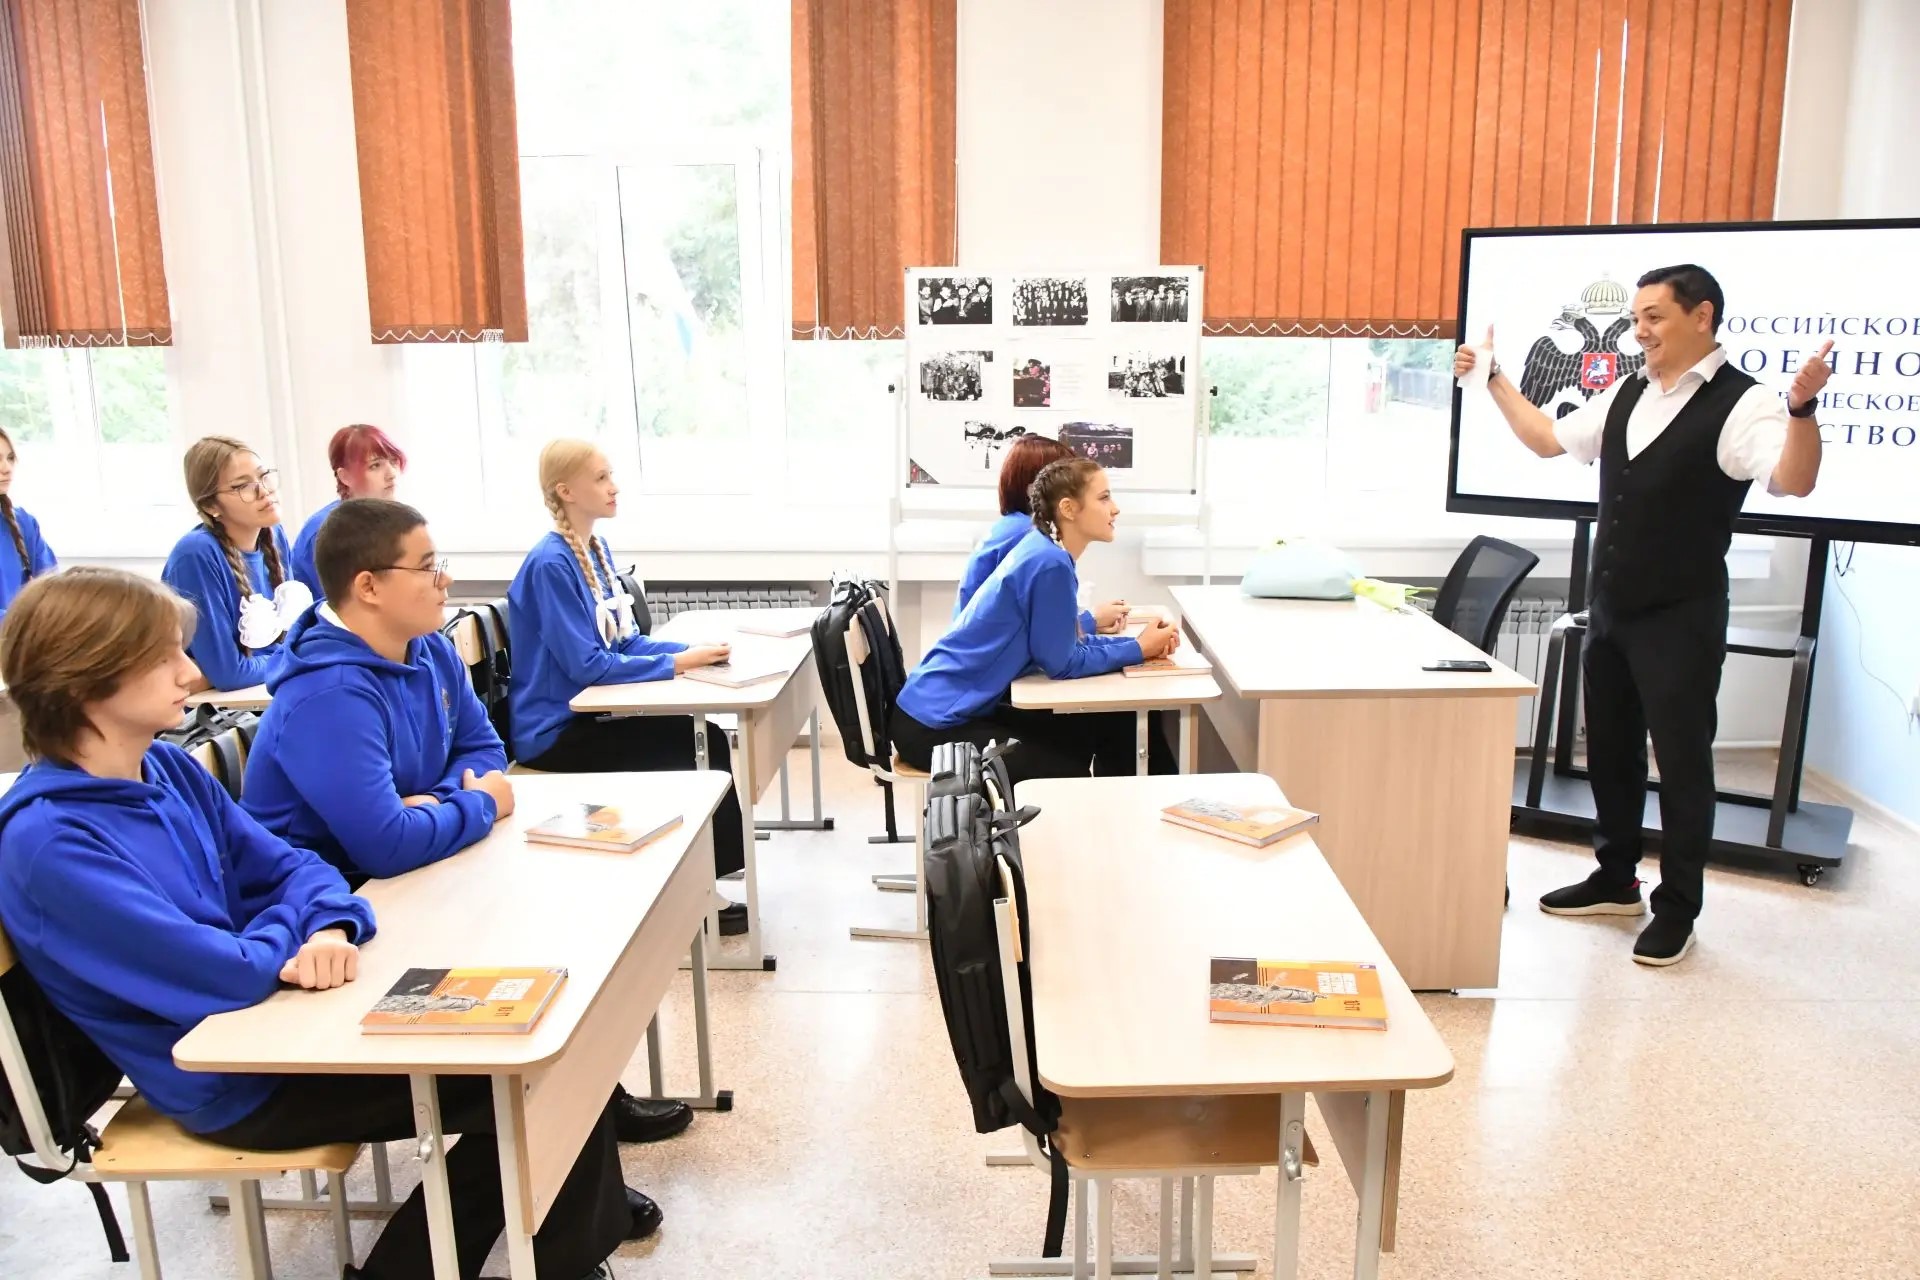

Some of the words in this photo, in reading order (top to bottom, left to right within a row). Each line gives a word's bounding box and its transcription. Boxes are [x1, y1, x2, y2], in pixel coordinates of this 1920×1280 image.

[1727, 312, 1920, 336] ОССИЙСКОЕ
[1740, 349, 1920, 376] ОЕННО
[1818, 423, 1916, 447] СТВО
